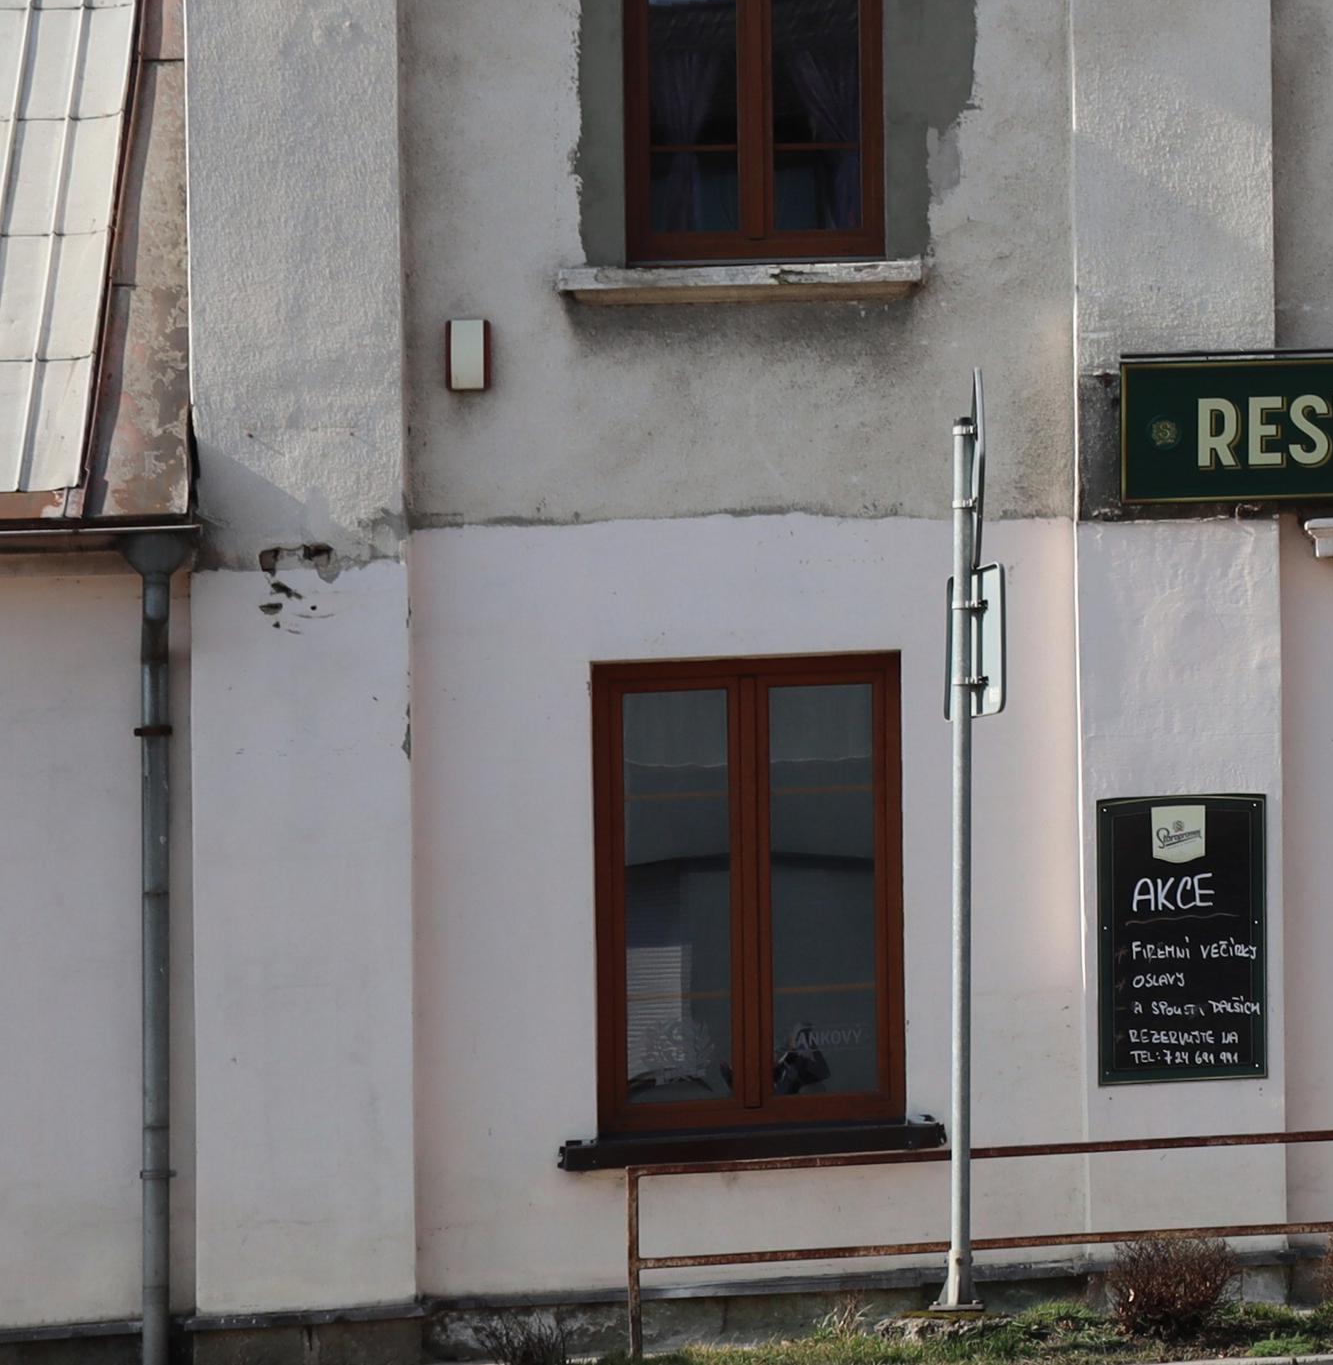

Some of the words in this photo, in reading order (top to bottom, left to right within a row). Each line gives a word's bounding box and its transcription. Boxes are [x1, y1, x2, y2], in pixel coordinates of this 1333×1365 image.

[1132, 872, 1215, 912] AKCE
[1131, 935, 1190, 960] FIREMNÍ
[1132, 972, 1186, 988] OSLAVY
[795, 1023, 862, 1050] ANKOVÝ
[1128, 1029, 1215, 1046] REZERVUJTE
[1221, 1031, 1239, 1044] NA
